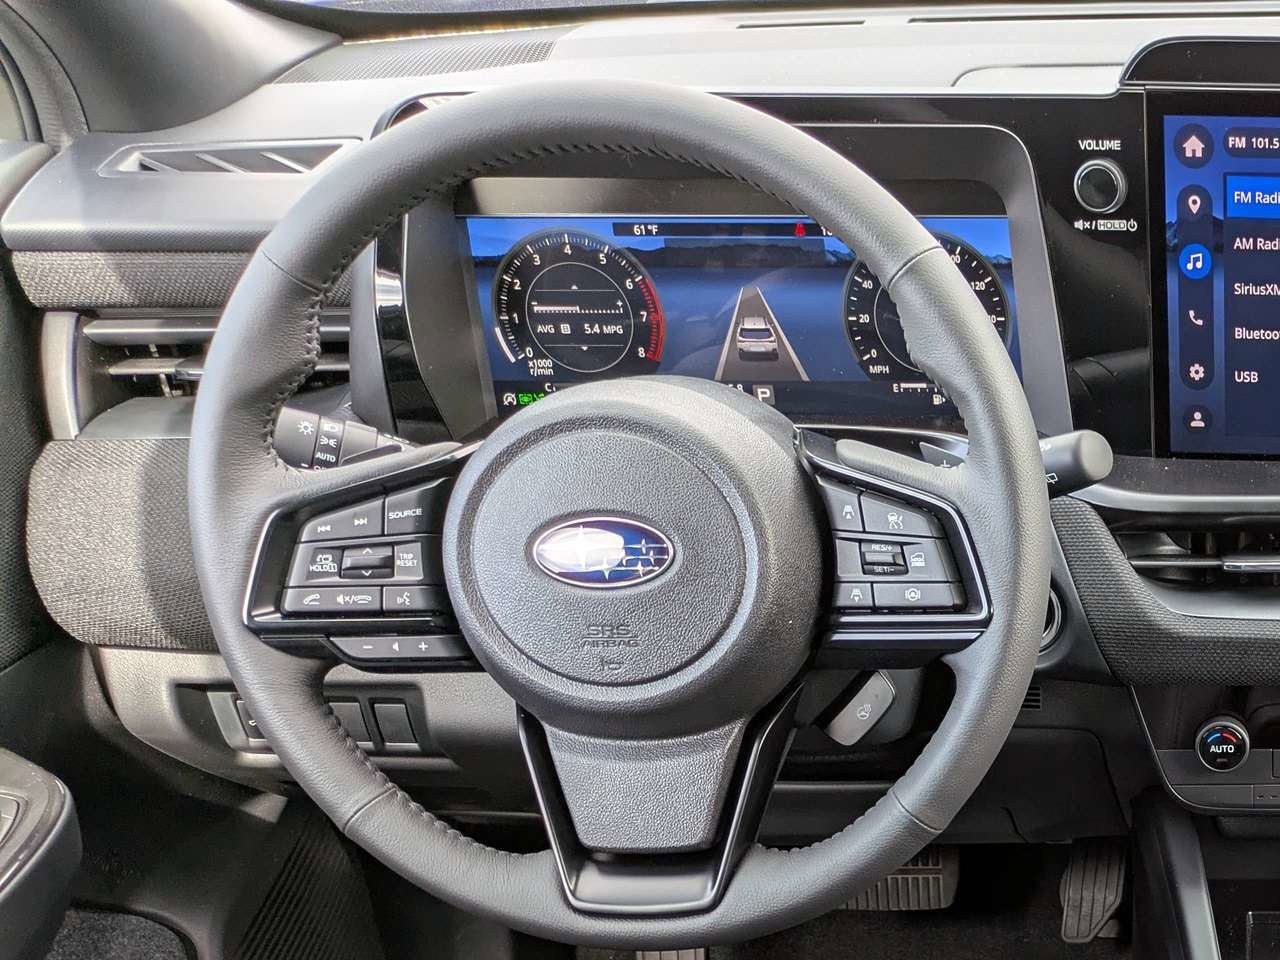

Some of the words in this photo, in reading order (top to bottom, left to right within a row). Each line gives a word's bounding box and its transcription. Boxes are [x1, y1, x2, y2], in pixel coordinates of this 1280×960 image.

[1078, 140, 1121, 150] VOLUME
[1228, 137, 1246, 149] FM
[1251, 137, 1280, 149] 101.5
[1234, 191, 1252, 204] FM
[1098, 220, 1127, 231] HOLD
[1233, 238, 1254, 250] AM
[564, 244, 572, 255] 4
[533, 254, 541, 265] 3
[600, 254, 607, 264] 5
[513, 280, 521, 290] 2
[625, 279, 633, 289] 6
[862, 281, 873, 289] 40
[971, 281, 985, 291] 120
[513, 313, 519, 324] 1
[640, 312, 647, 322] 7
[859, 314, 870, 323] 20
[537, 324, 555, 334] AVG
[584, 323, 601, 335] 5.4
[603, 324, 624, 334] MPG
[526, 348, 533, 358] 0
[638, 348, 645, 358] 8
[871, 349, 877, 358] 0
[530, 366, 554, 376] r/min
[869, 365, 889, 374] MPH
[1234, 371, 1259, 383] USB
[893, 384, 899, 392] E
[757, 388, 770, 401] P
[316, 452, 336, 463] AUTO
[389, 508, 422, 519] SOURCE
[400, 553, 413, 561] TRIP
[309, 563, 329, 573] HOLD
[587, 624, 631, 637] SRS
[581, 639, 641, 648] AIRBAG
[1210, 745, 1234, 753] AUTO
